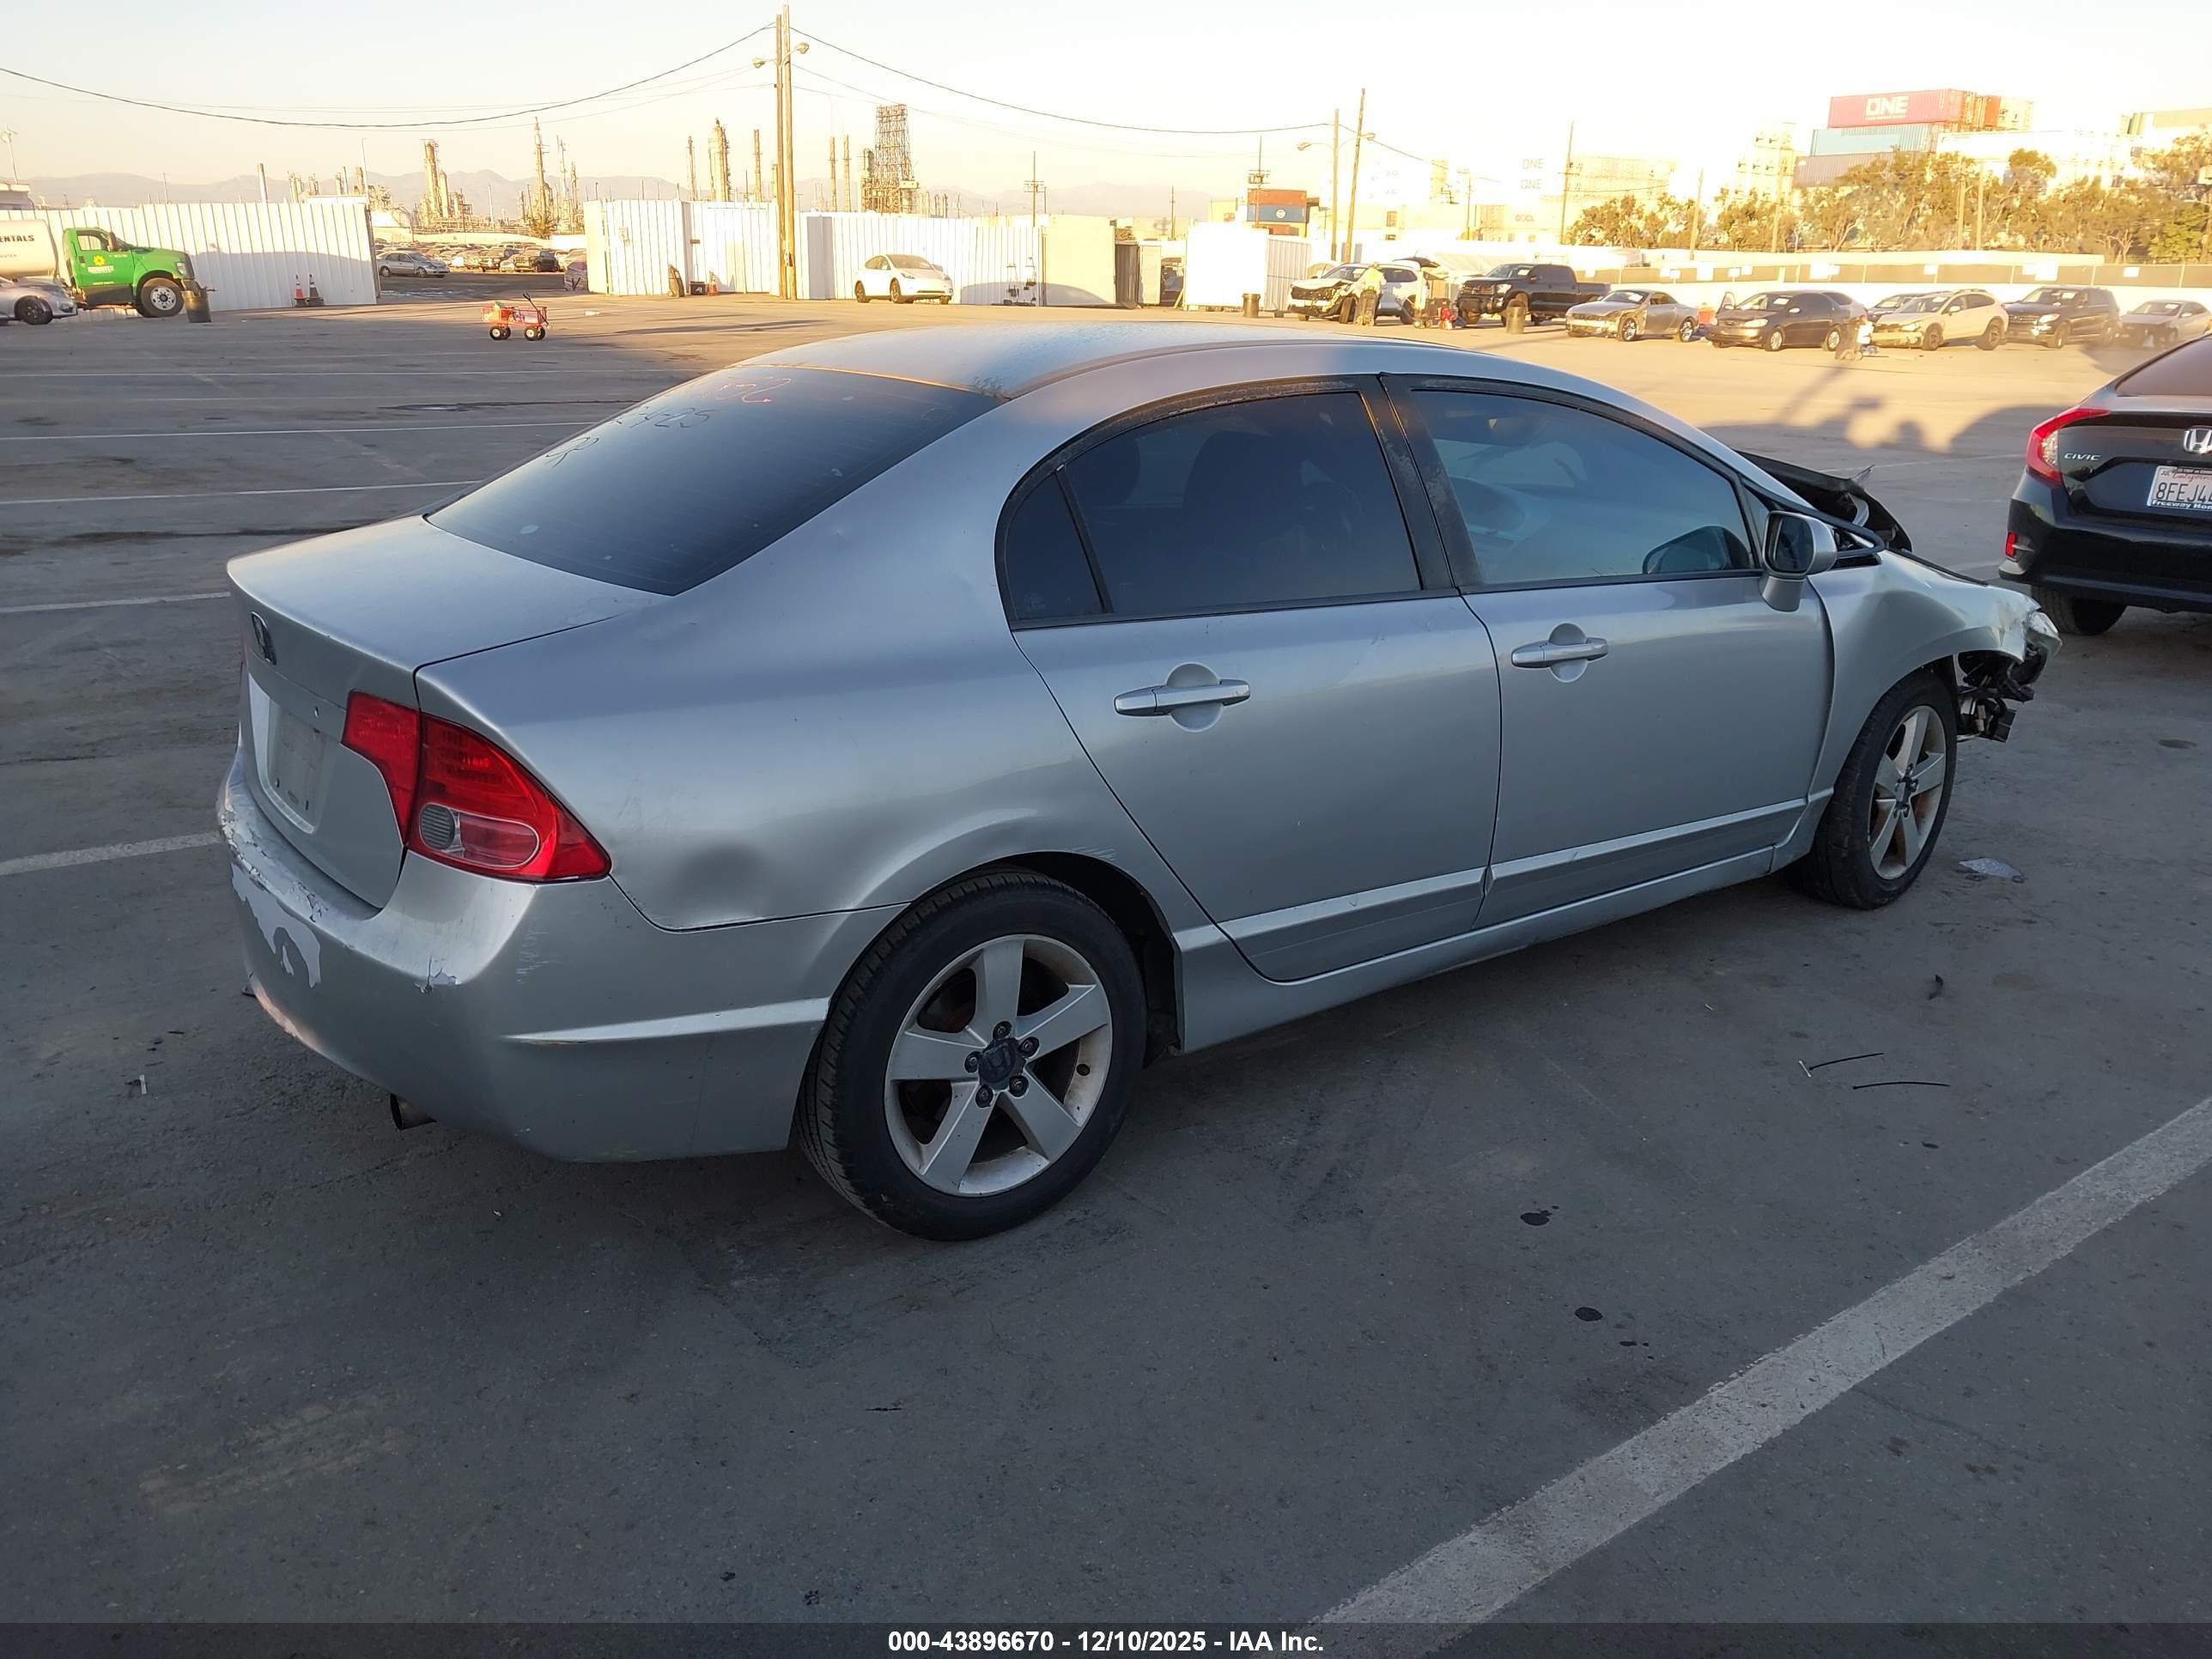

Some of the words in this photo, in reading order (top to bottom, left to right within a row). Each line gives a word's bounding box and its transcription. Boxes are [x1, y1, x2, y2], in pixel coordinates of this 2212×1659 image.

[1865, 95, 1910, 116] ONE
[1522, 158, 1545, 170] ONE
[1521, 179, 1541, 190] ONE
[2063, 453, 2103, 461] CIVIC
[2152, 500, 2191, 509] Freeway
